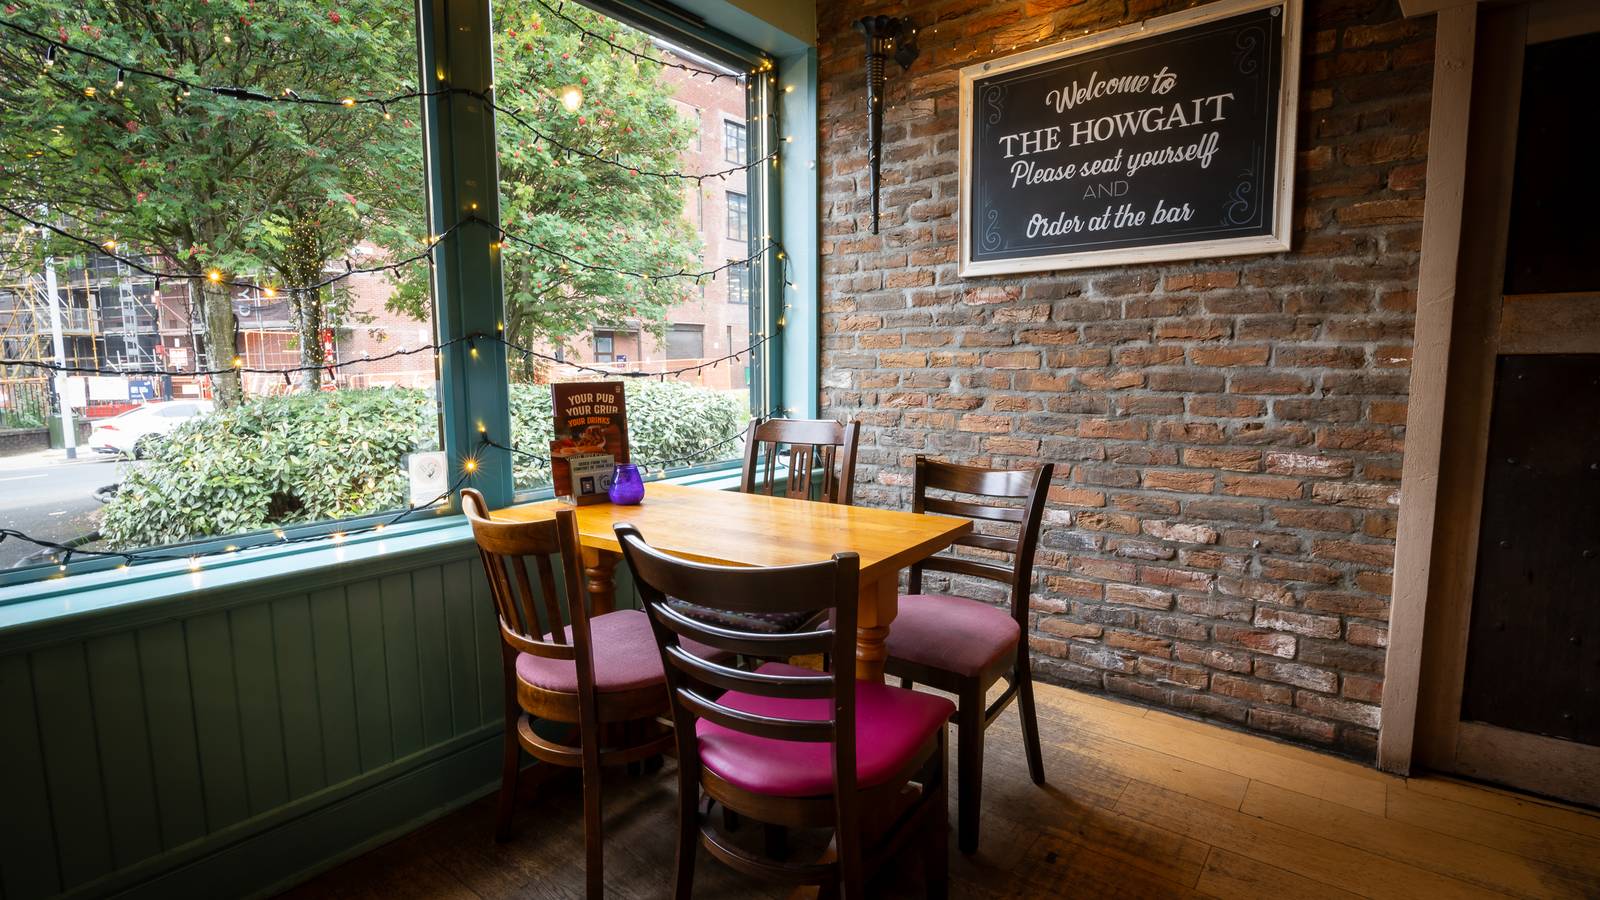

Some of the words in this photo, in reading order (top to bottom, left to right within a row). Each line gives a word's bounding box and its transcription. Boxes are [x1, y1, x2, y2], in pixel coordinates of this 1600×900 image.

[1045, 71, 1150, 114] Welcome
[1151, 66, 1178, 95] to
[999, 126, 1062, 159] THE
[1069, 93, 1235, 148] HOWGAIT
[1010, 161, 1076, 189] Please
[1080, 149, 1123, 176] seat
[1127, 131, 1219, 176] yourself
[1083, 180, 1129, 200] AND
[1026, 213, 1085, 239] Order
[1088, 207, 1112, 231] at
[1113, 205, 1146, 228] the
[1151, 200, 1195, 224] bar
[566, 405, 591, 416] YOUR
[568, 393, 593, 406] YOUR
[596, 393, 615, 404] PUB
[568, 418, 585, 427] YOUR
